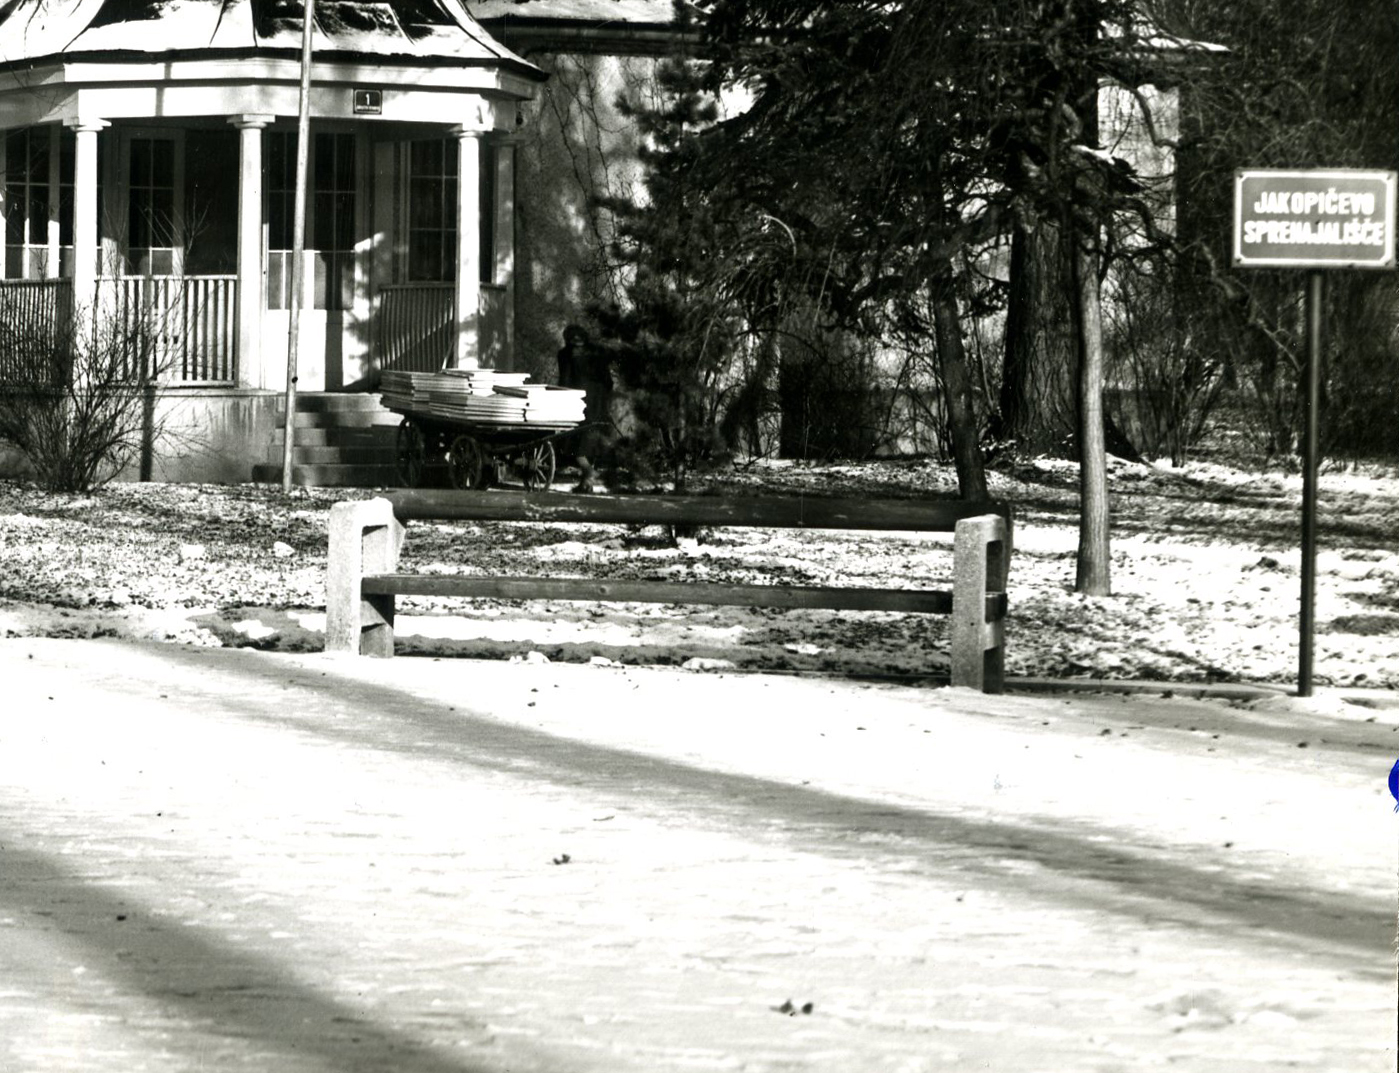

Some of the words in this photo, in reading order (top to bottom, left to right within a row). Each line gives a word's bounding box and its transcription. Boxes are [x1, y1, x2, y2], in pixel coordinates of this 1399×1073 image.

[365, 93, 370, 105] 1
[1254, 188, 1375, 215] JAKOPIČEVO
[1244, 218, 1384, 245] SPREHAJALIŠČE
